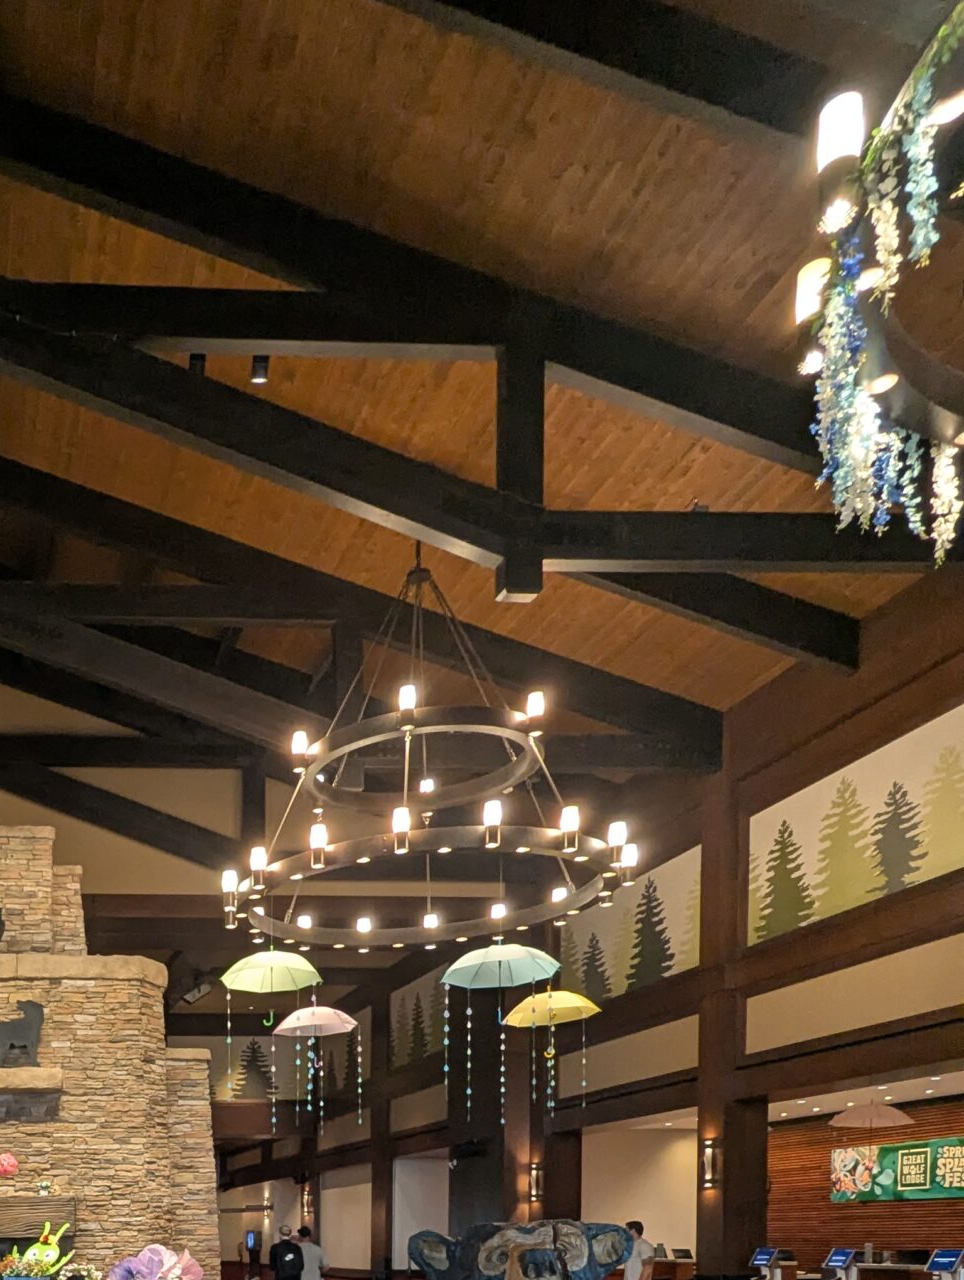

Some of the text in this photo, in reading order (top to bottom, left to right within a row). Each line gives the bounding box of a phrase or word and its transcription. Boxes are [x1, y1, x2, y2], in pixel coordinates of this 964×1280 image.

[903, 1155, 925, 1164] GREAT
[902, 1164, 925, 1174] WOLF
[902, 1174, 925, 1184] LODGE
[943, 1173, 964, 1187] FE
